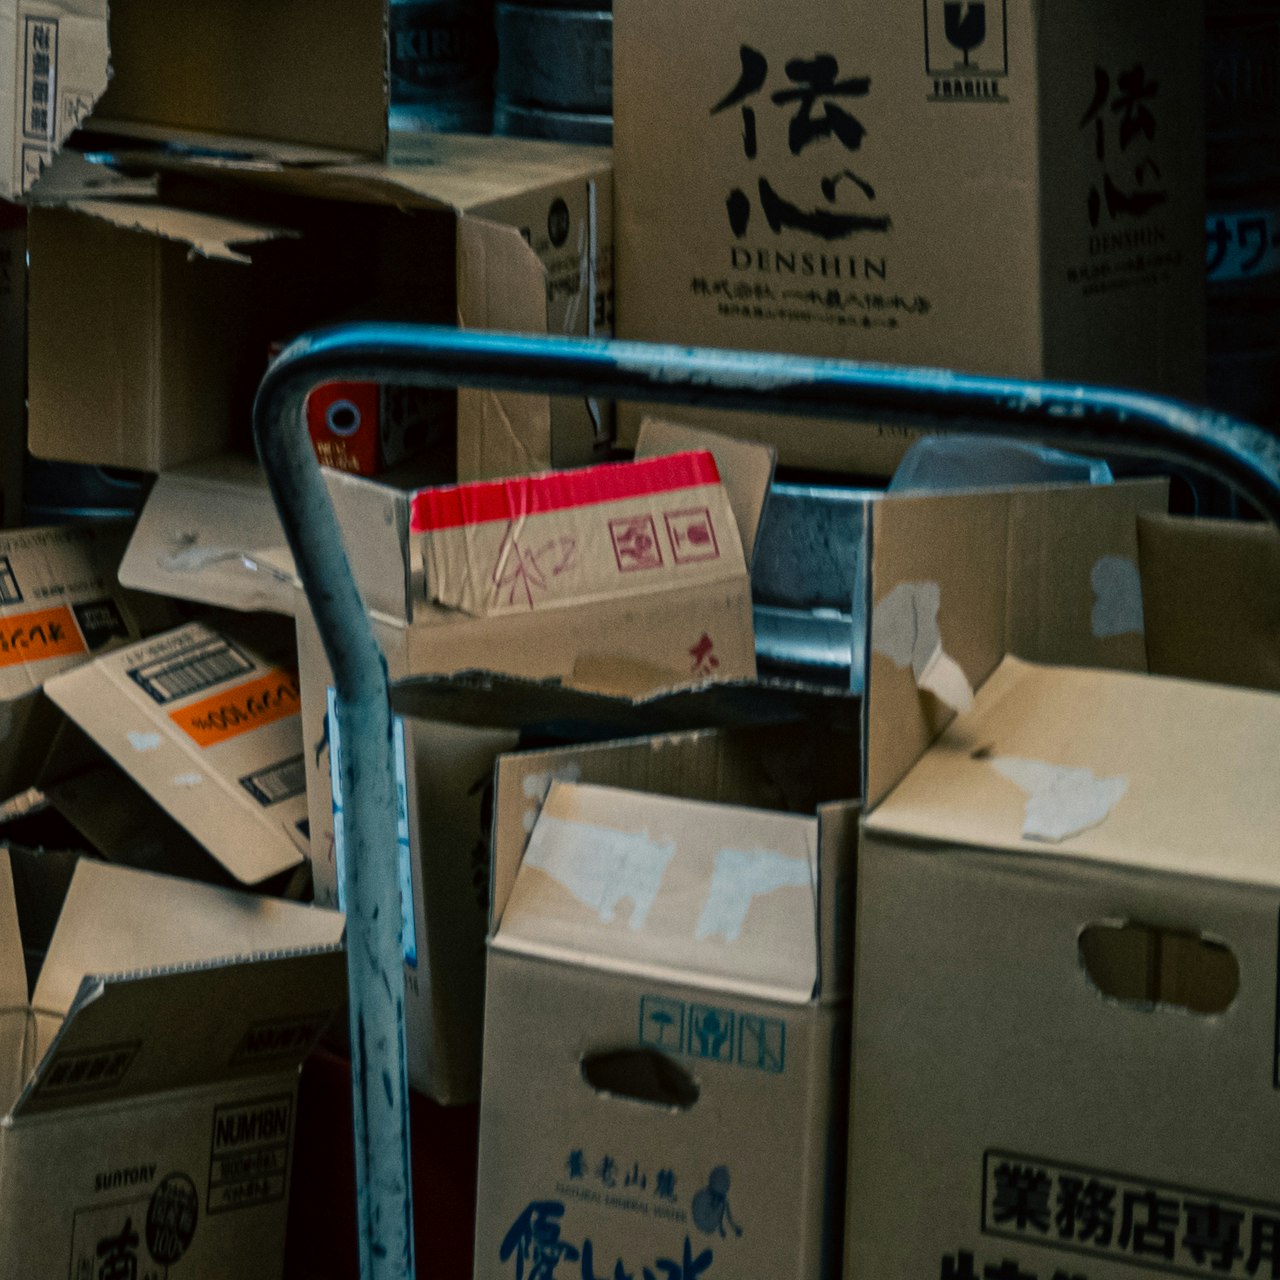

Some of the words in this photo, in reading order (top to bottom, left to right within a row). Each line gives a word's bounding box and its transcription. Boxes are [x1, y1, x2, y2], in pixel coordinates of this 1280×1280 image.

[933, 79, 1001, 100] FRAGILE
[709, 44, 893, 240] 伝心
[731, 247, 888, 282] DENSHIN
[216, 1108, 288, 1147] NUM18N
[94, 1163, 157, 1192] SUNTORY
